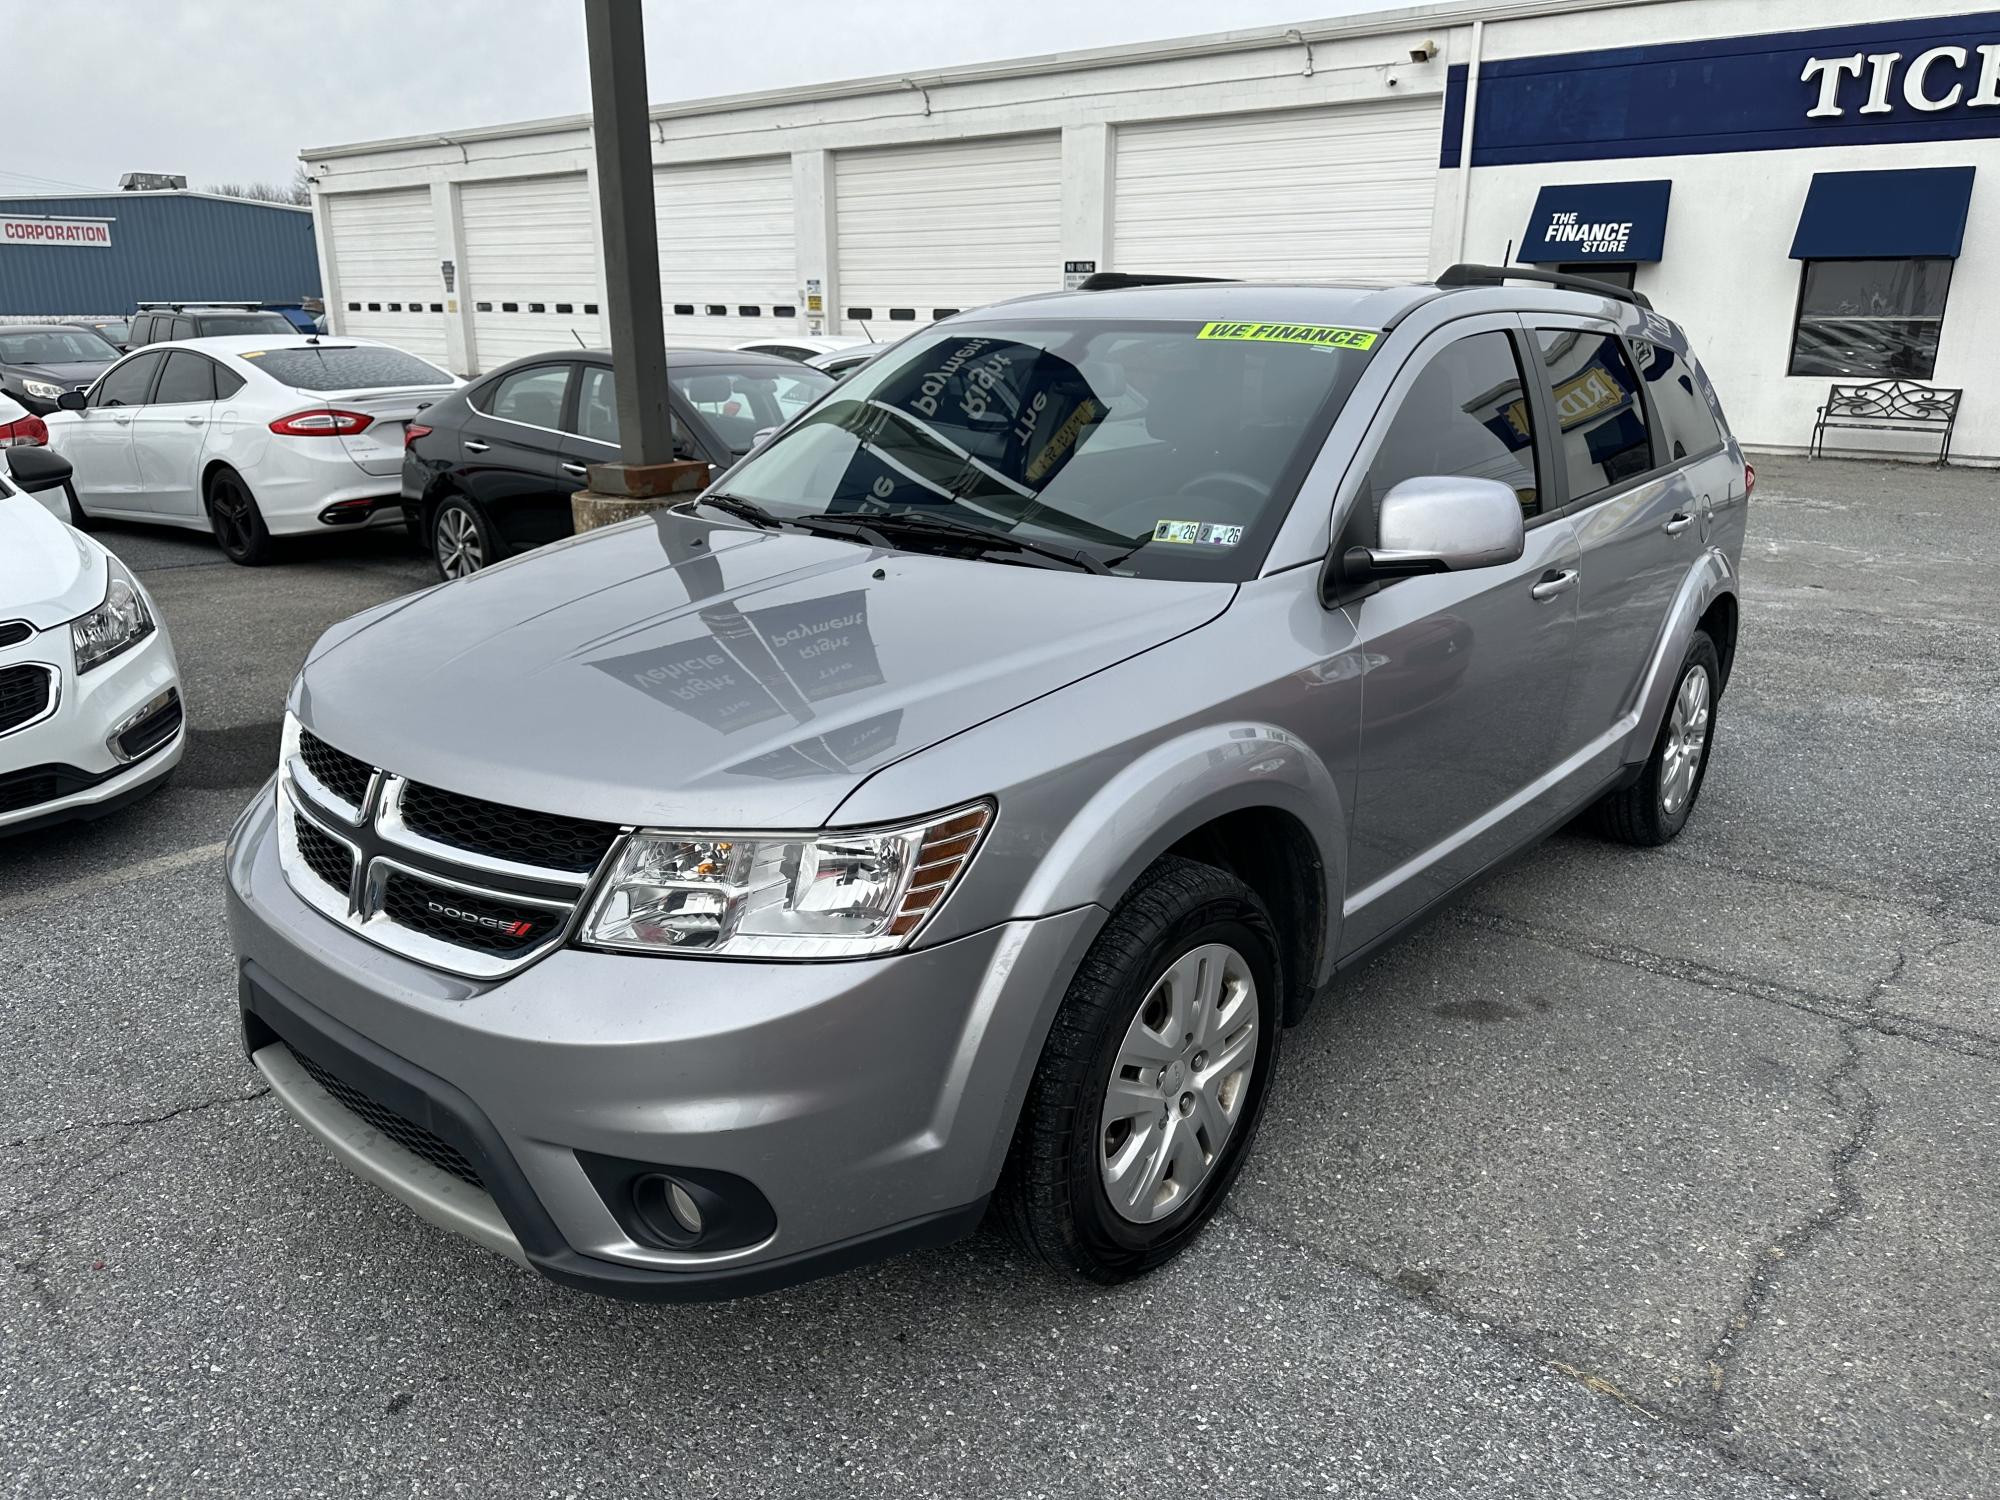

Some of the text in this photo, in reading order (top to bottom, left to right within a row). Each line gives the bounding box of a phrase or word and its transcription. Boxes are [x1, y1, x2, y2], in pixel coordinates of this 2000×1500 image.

[1552, 213, 1578, 225] THE
[5, 223, 107, 241] CORPORATION
[1545, 223, 1632, 242] FINANCE
[1581, 241, 1627, 252] STORE
[1208, 324, 1371, 347] WE FINANCE
[1183, 525, 1196, 540] 26
[1227, 528, 1241, 543] 26
[428, 901, 516, 932] DODGE
